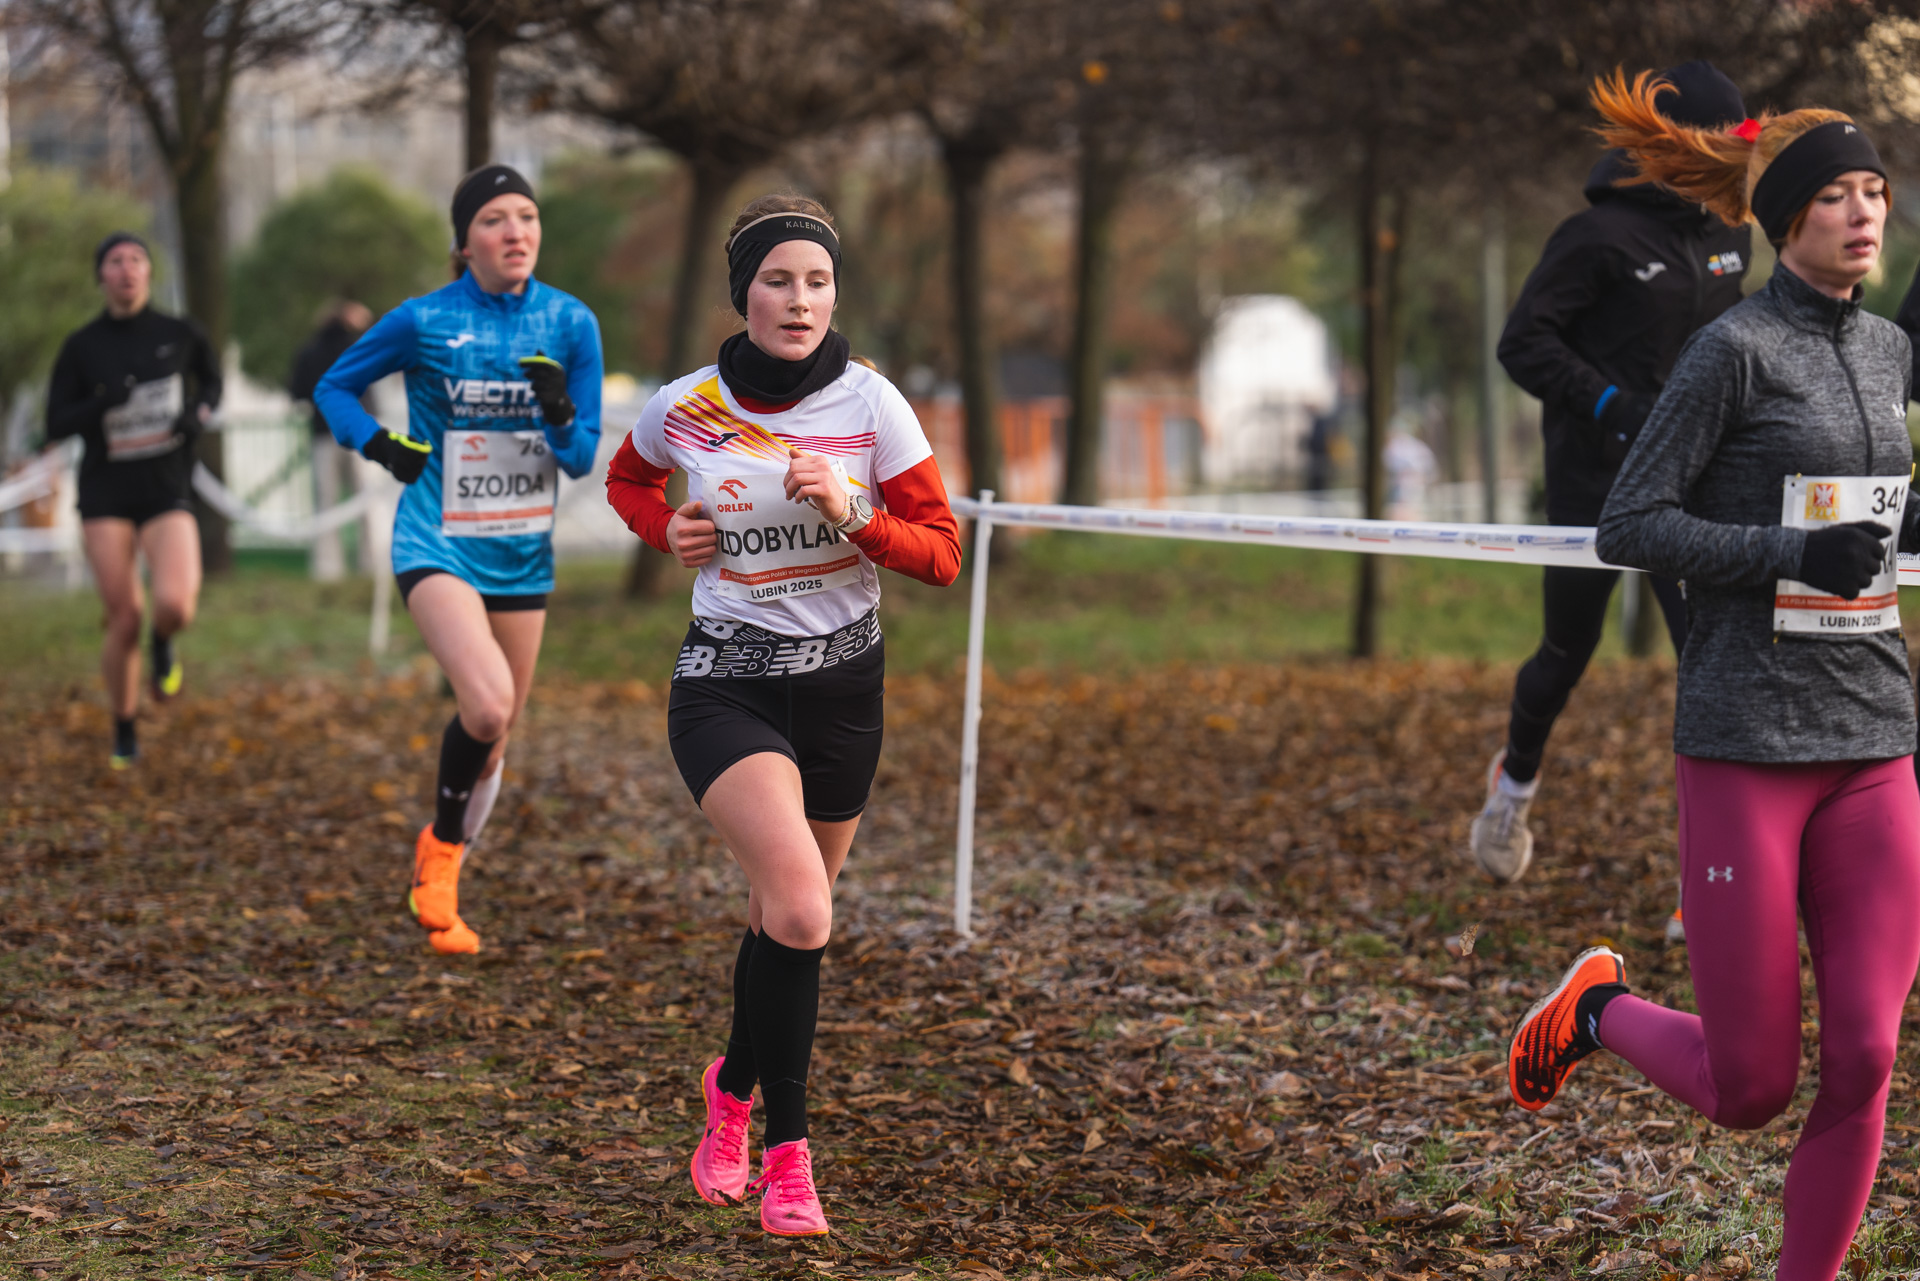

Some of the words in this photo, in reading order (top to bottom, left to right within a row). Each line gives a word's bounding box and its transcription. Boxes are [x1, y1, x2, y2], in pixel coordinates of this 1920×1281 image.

[785, 220, 823, 234] KALENJI
[457, 472, 545, 499] SZOJDA
[717, 502, 753, 513] ORLEN
[770, 569, 788, 578] Polski
[794, 566, 819, 575] Biegach
[751, 584, 788, 599] LUBIN
[790, 579, 823, 593] 2025
[1820, 615, 1860, 628] LUBIN
[1861, 614, 1882, 627] 2025
